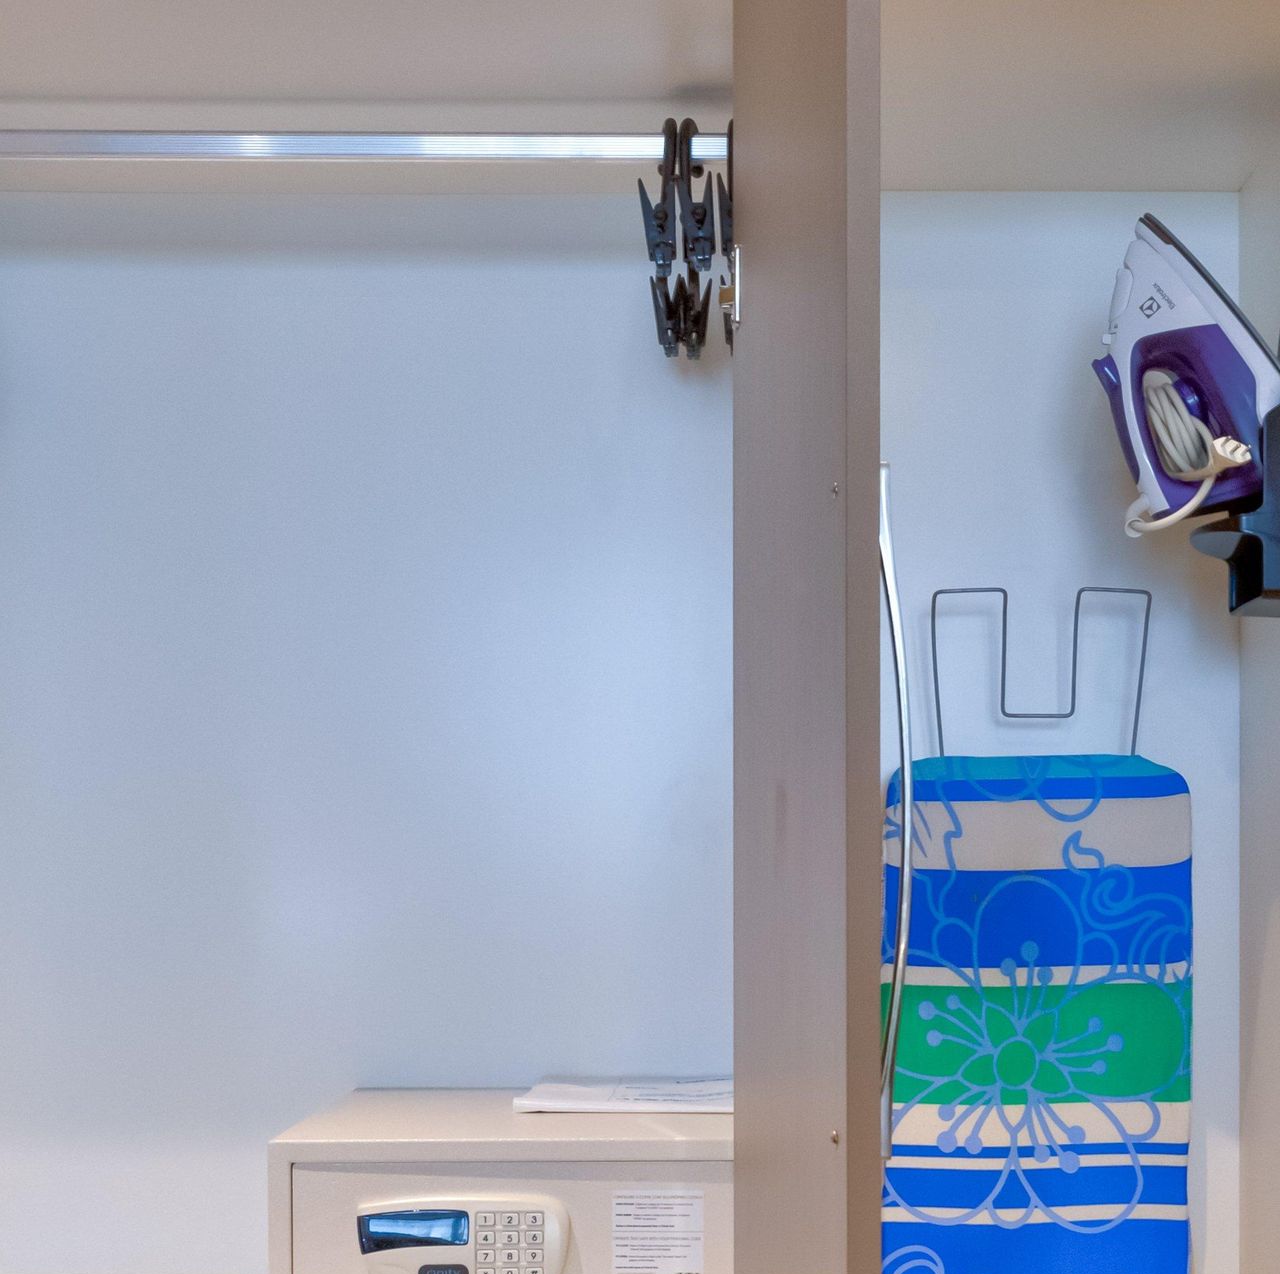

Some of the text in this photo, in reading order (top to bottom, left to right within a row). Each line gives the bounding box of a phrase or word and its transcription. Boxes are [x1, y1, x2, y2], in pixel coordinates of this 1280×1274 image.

[506, 1216, 513, 1224] 2
[531, 1216, 538, 1224] 3
[482, 1234, 538, 1242] 4 5 6
[483, 1252, 536, 1261] 7 8 9
